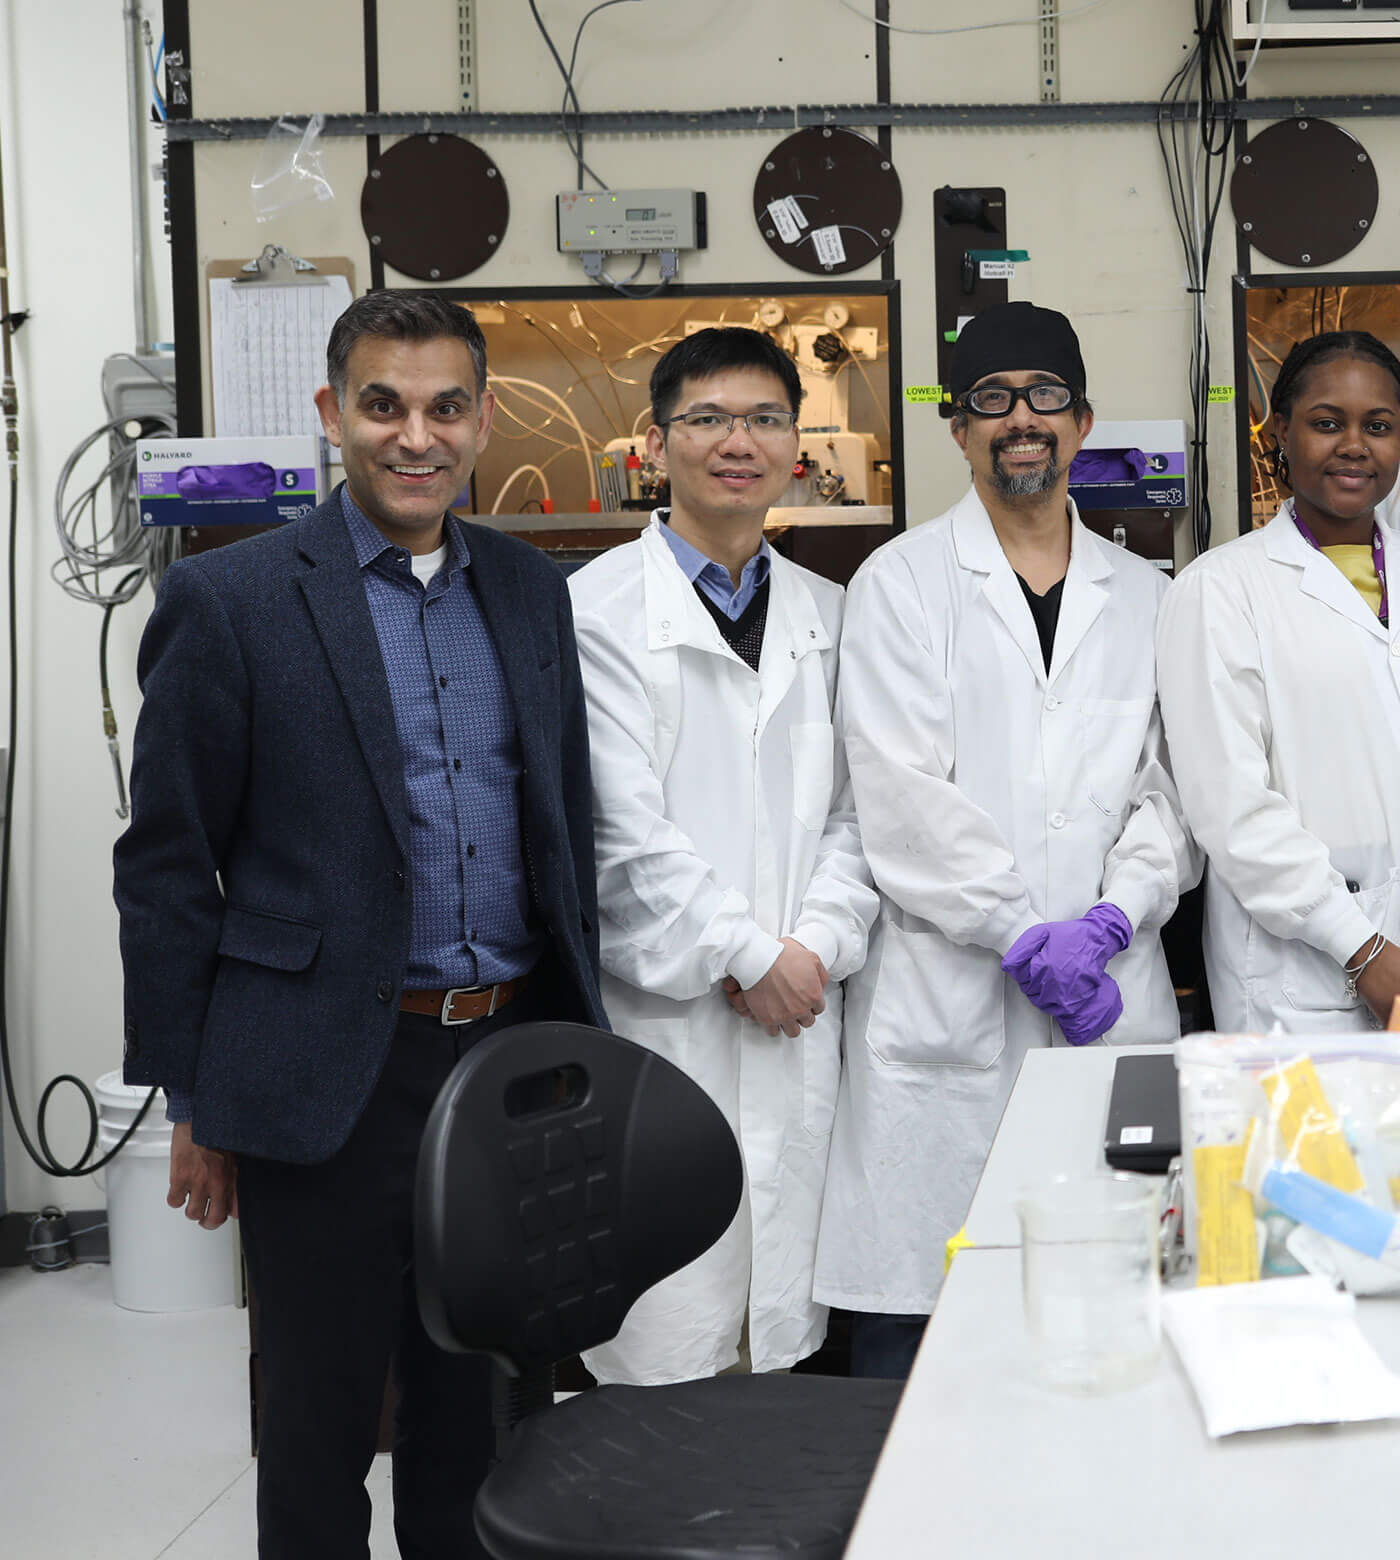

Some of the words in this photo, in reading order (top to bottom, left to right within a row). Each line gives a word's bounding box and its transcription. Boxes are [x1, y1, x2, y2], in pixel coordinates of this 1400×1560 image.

[906, 387, 942, 395] LOWEST
[1208, 386, 1232, 394] WEST
[153, 451, 193, 460] HALYARD
[1155, 458, 1163, 470] L
[285, 473, 294, 486] S
